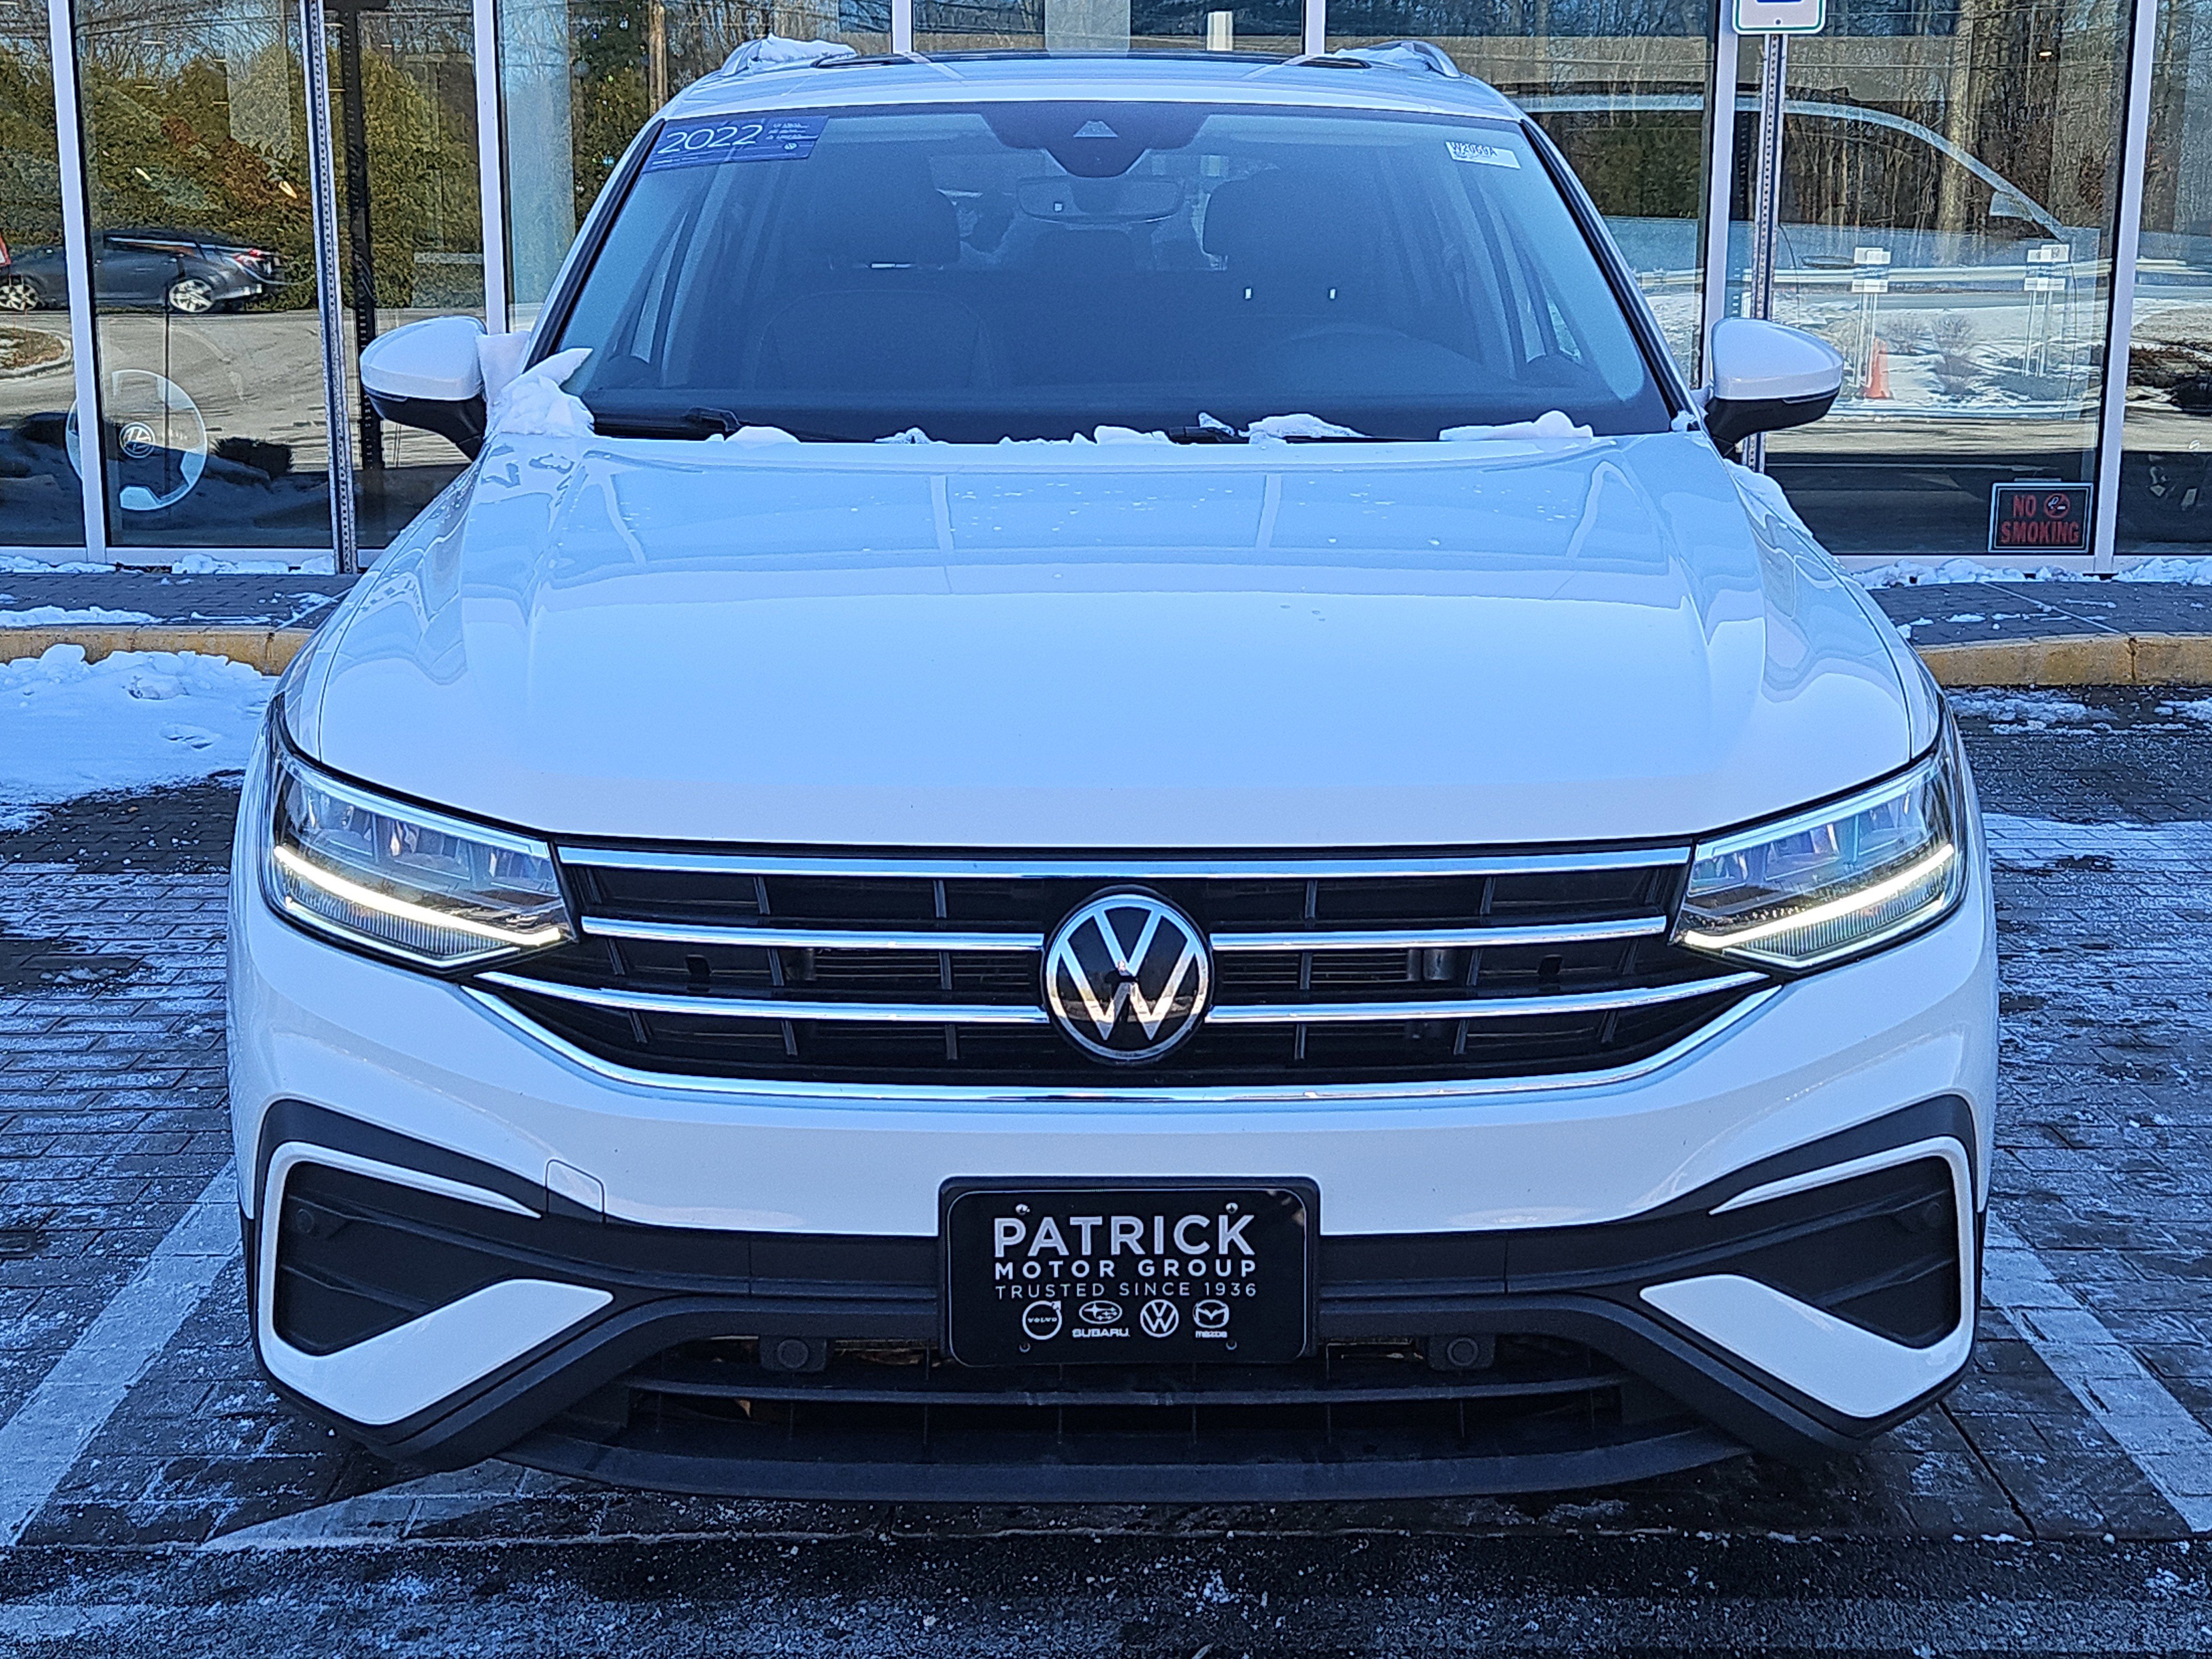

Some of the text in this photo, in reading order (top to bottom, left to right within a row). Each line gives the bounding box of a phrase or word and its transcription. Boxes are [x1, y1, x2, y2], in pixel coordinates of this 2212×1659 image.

[658, 125, 762, 153] 2022
[2012, 494, 2037, 517] NO
[2001, 520, 2079, 544] SMOKING
[1053, 902, 1201, 1042] VW
[994, 1215, 1255, 1257] PATRICK
[995, 1259, 1256, 1280] MOTOR GROUP
[995, 1282, 1257, 1299] TRUSTED SINCE 1936
[1141, 1301, 1178, 1334] VW
[1072, 1328, 1129, 1338] SUBARU
